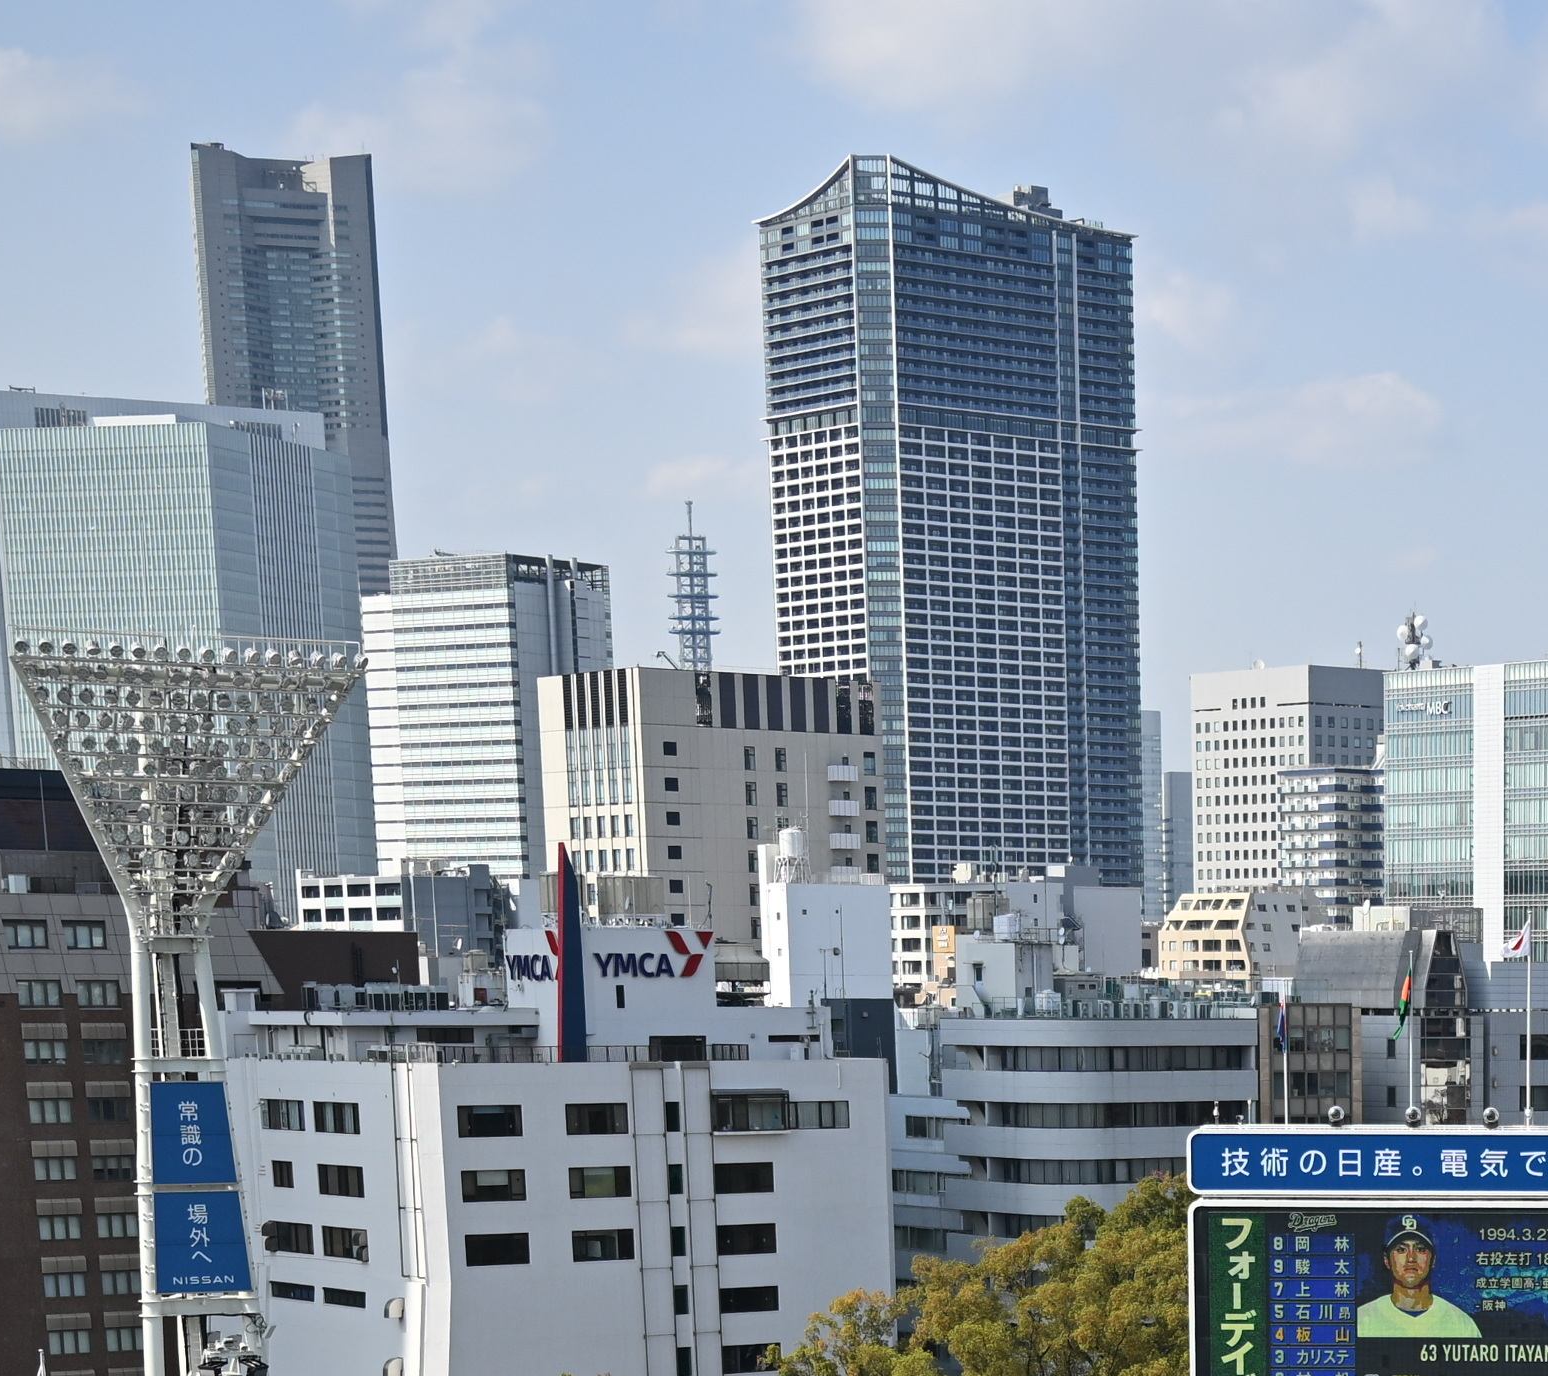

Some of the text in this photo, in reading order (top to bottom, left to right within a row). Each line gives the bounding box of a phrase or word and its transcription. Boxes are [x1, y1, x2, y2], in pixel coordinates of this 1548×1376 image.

[505, 955, 552, 981] YMCA
[594, 953, 674, 977] YMCA
[178, 1101, 203, 1166] 常識の
[1288, 1212, 1337, 1232] Dragons
[188, 1204, 212, 1263] 場外へ
[1476, 1252, 1532, 1267] 右投左打
[173, 1275, 235, 1285] NISSAN
[1420, 1345, 1437, 1363] 63
[1442, 1345, 1499, 1363] YUTARO
